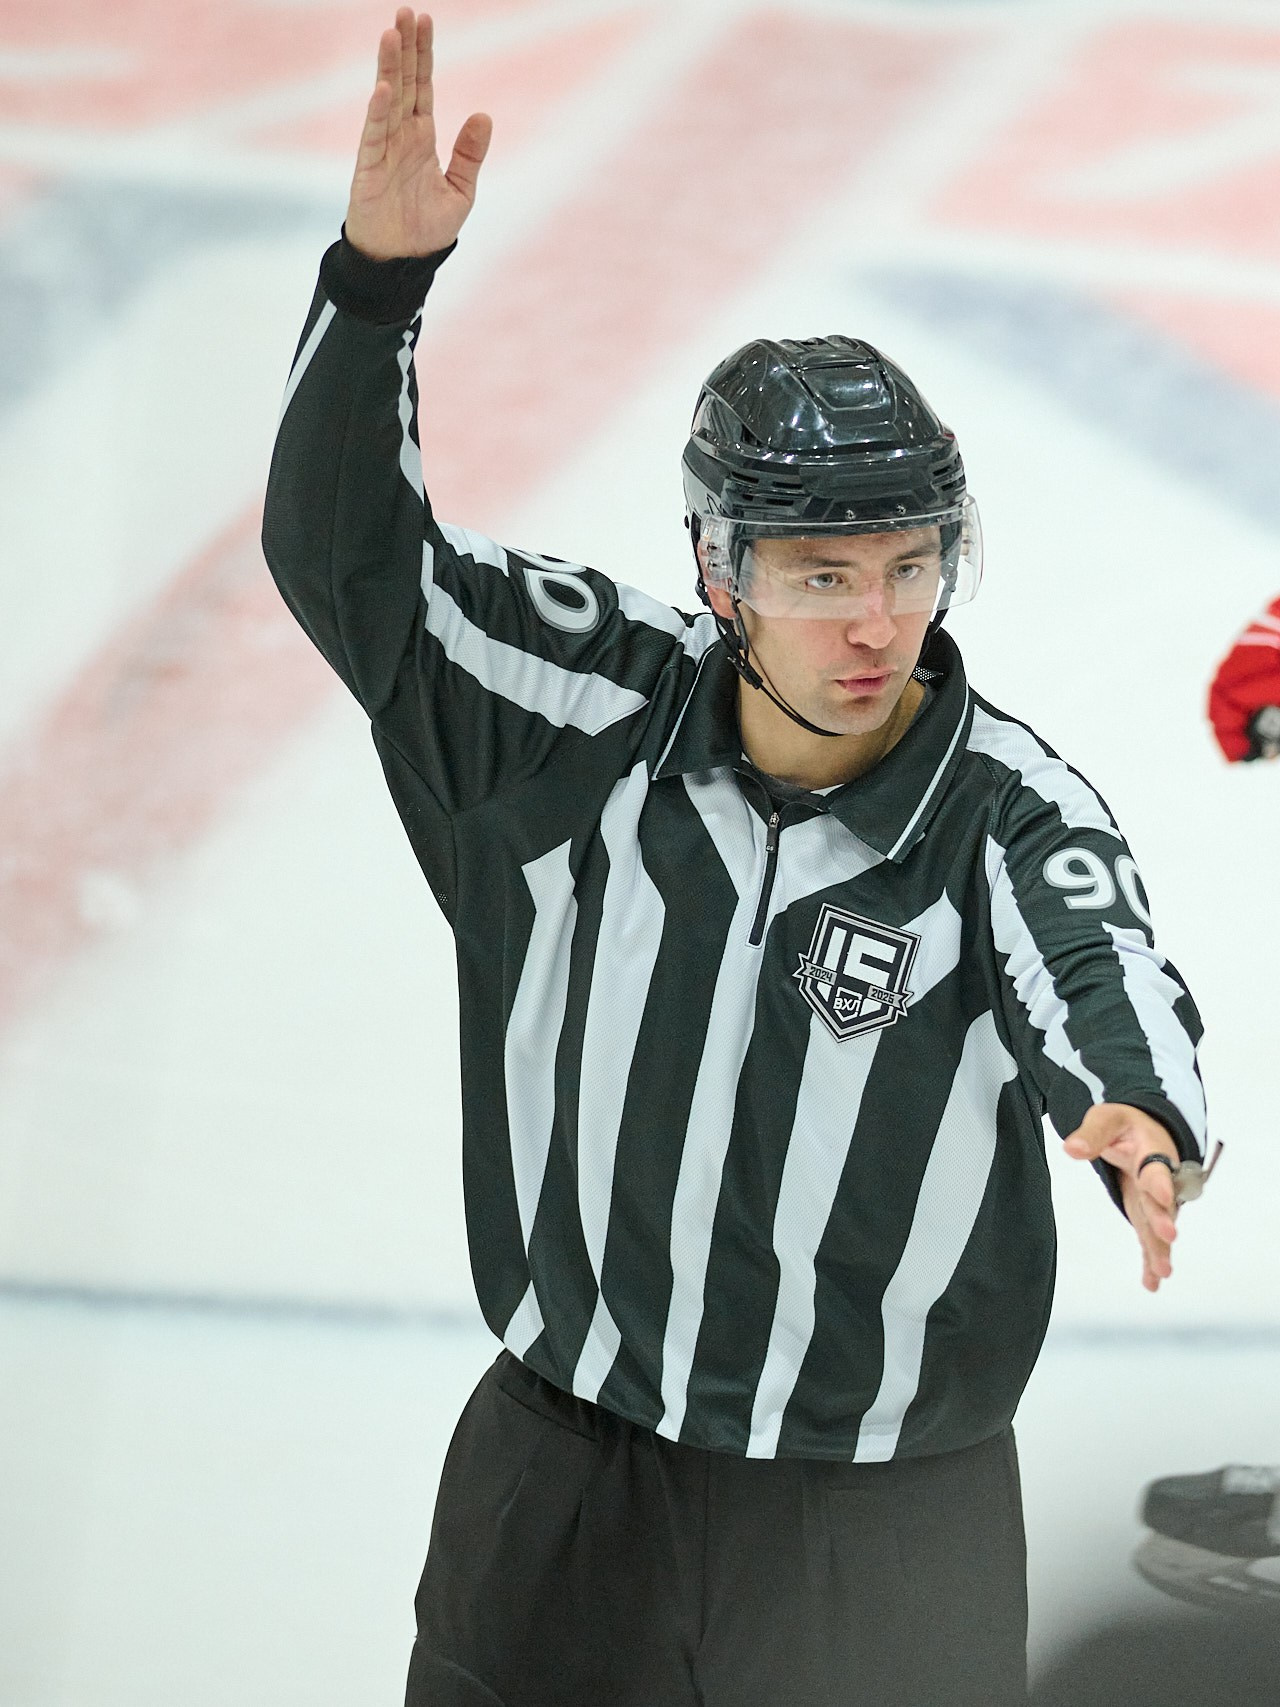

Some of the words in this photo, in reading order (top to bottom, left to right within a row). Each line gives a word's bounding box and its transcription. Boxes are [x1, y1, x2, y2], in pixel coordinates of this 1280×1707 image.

[1043, 847, 1152, 929] 90
[809, 966, 833, 982] 2024
[871, 988, 895, 1003] 2025
[833, 997, 862, 1012] ВХЛ
